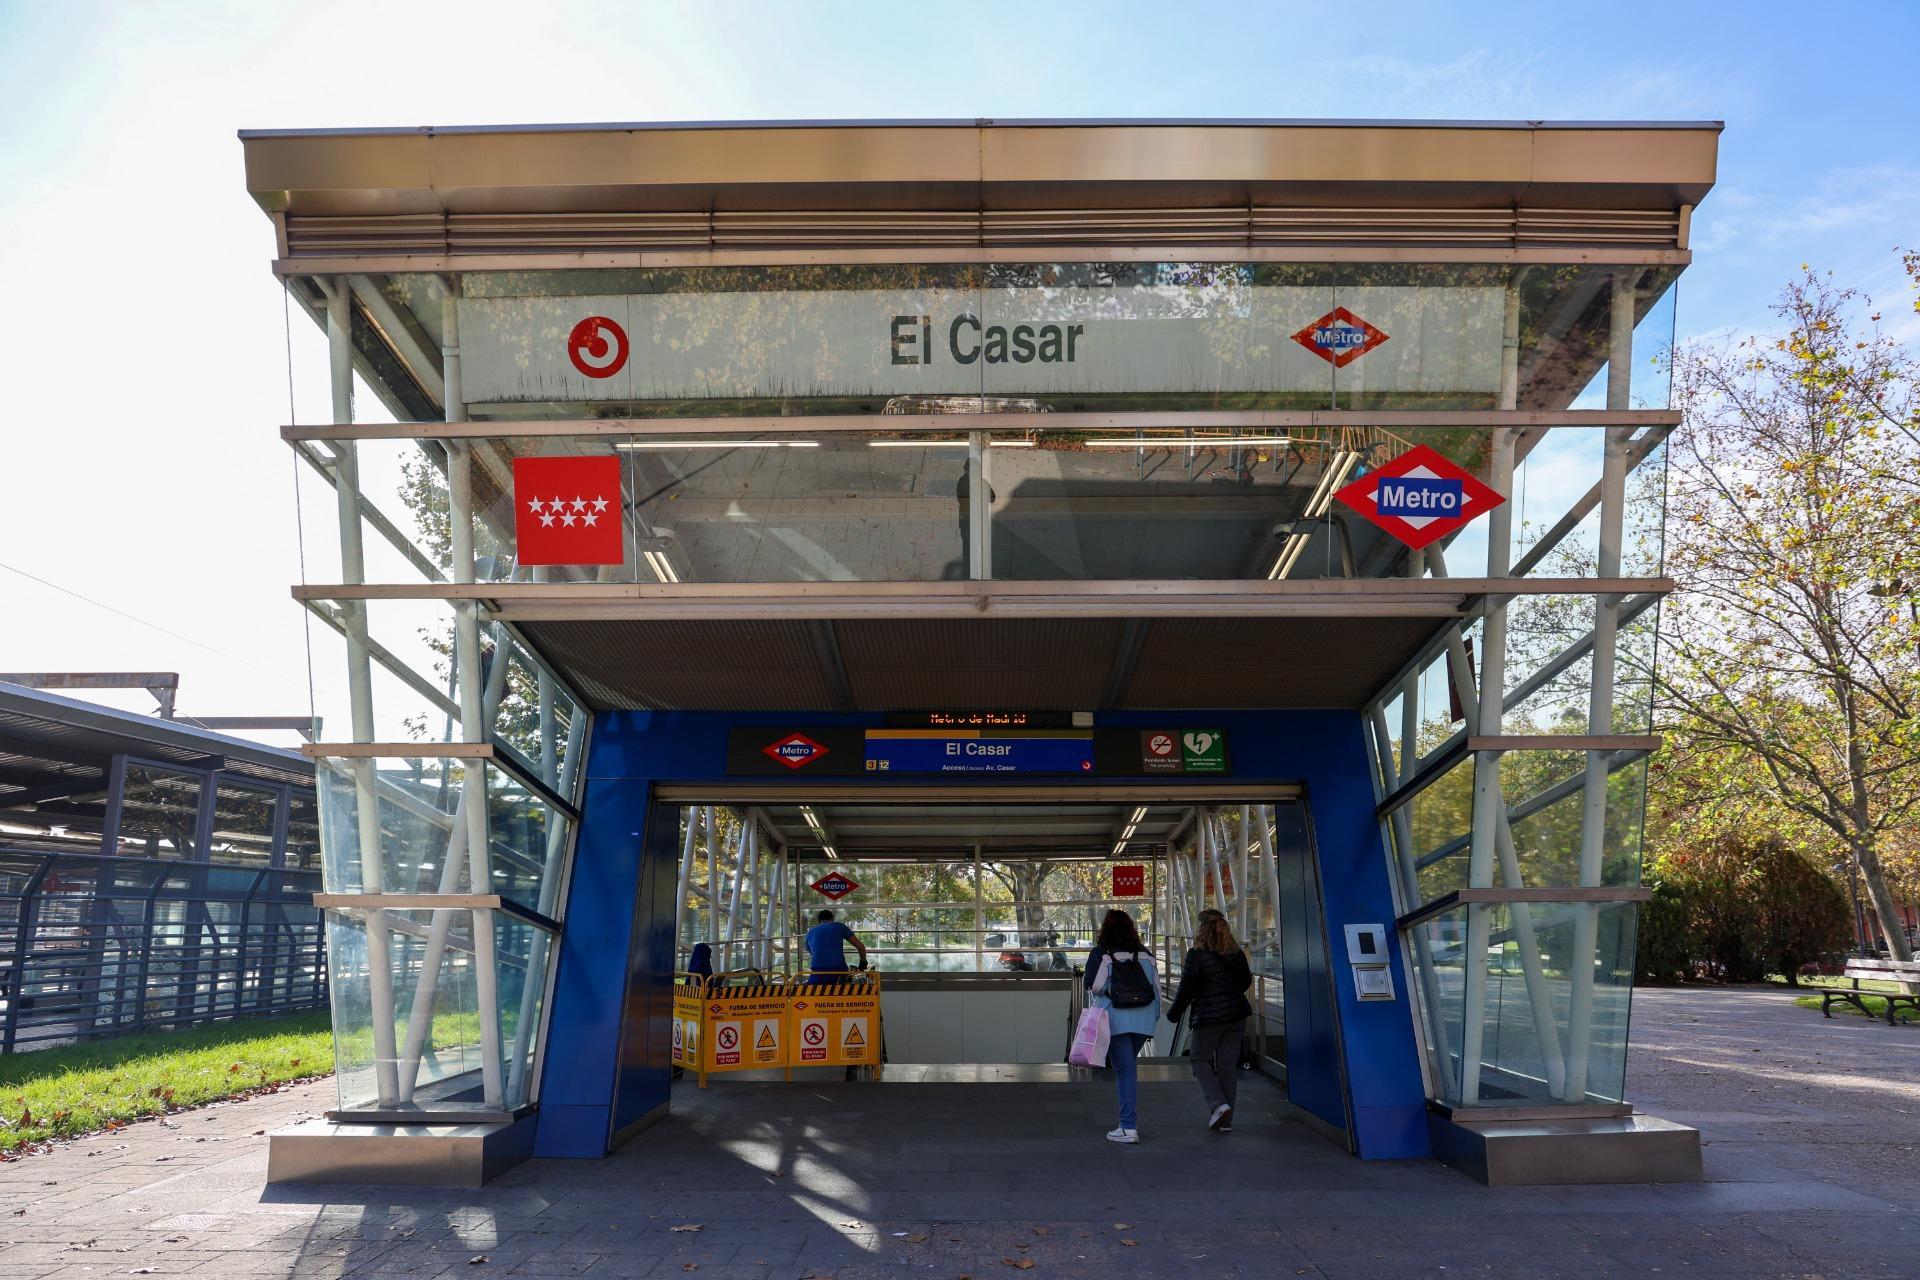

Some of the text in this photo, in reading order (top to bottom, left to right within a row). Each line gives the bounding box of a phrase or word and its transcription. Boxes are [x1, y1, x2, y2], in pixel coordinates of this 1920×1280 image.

[891, 313, 1084, 365] El Casar
[1317, 330, 1363, 344] Metro
[1383, 485, 1456, 509] Metro
[782, 746, 809, 755] Metro
[946, 742, 1012, 756] El Casar
[879, 761, 889, 769] 12
